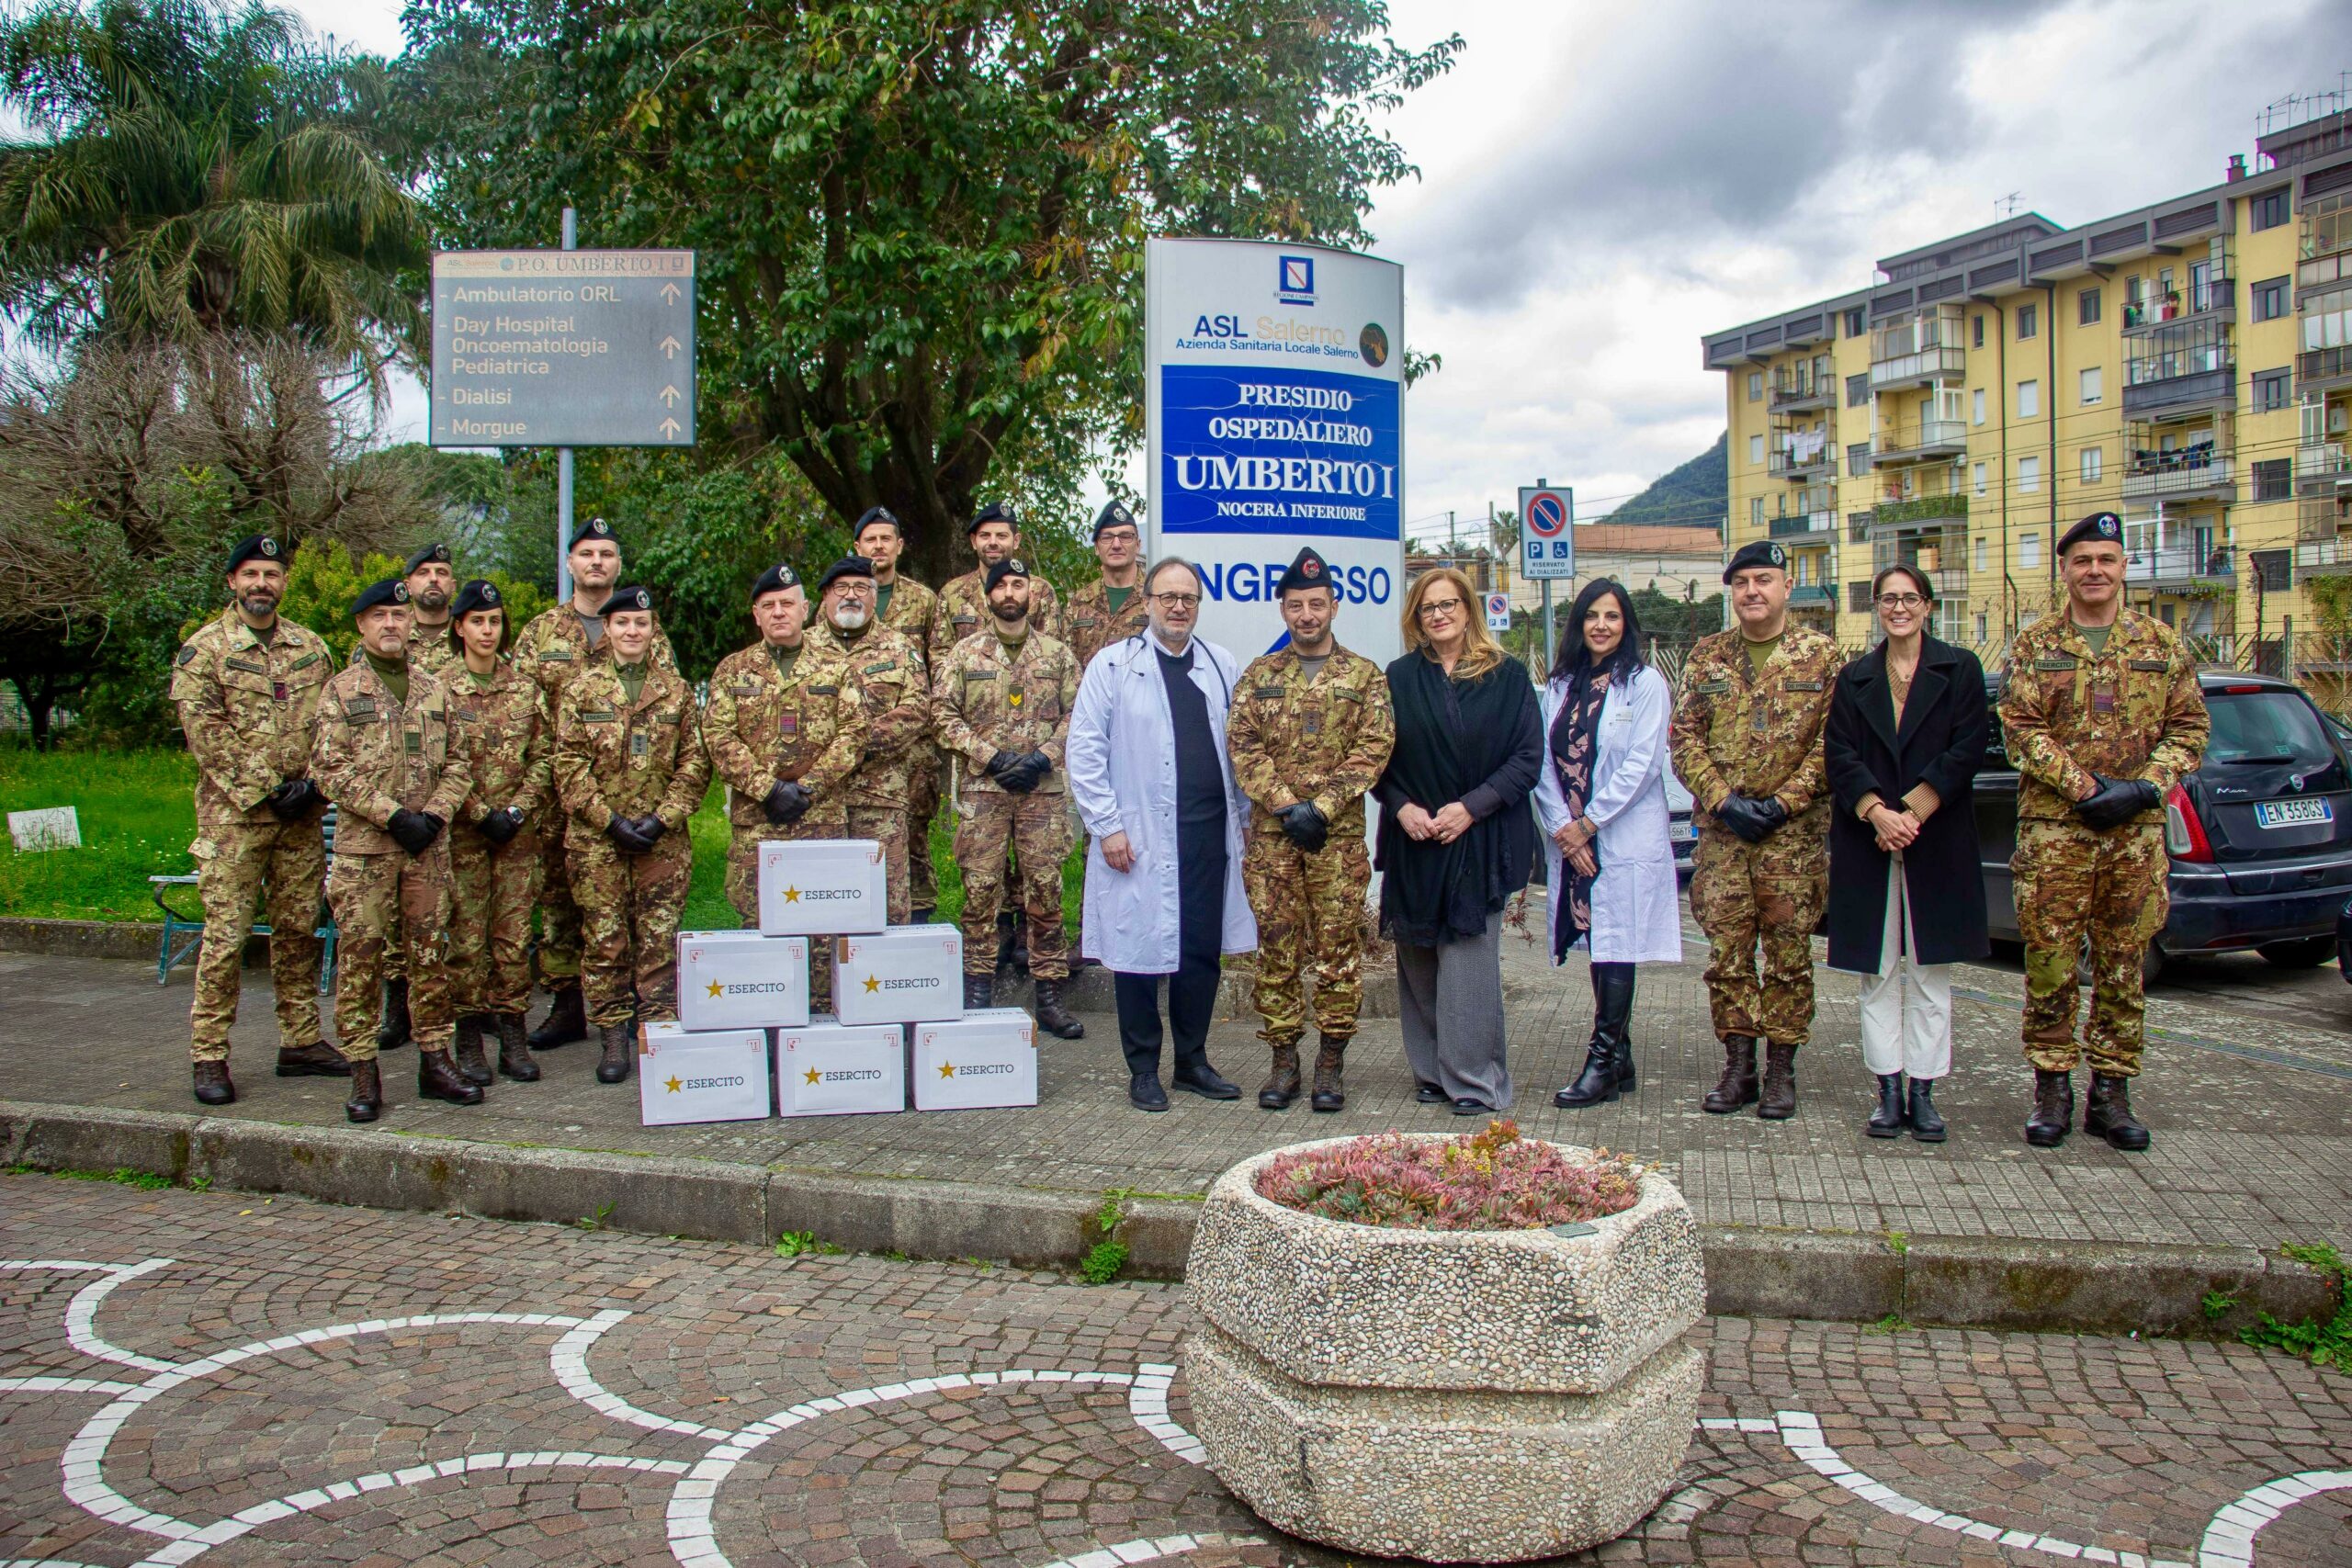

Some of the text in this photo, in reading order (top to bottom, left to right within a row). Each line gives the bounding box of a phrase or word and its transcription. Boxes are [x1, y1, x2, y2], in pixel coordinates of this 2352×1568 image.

[557, 256, 652, 272] UMBERTO
[657, 256, 664, 271] I
[453, 286, 621, 303] Ambulatorio ORL
[453, 316, 575, 337] Day Hospital
[1193, 315, 1346, 345] ASL Salerno
[452, 336, 608, 357] Oncoematologia
[1176, 338, 1359, 360] Azienda Sanitaria Locale Salerno
[452, 358, 549, 375] Pediatrica
[452, 388, 512, 405] Dialisi
[1238, 384, 1353, 412] PRESIDIO
[452, 418, 526, 439] Morgue
[1208, 417, 1373, 447] OSPEDALIERO
[1174, 455, 1394, 499] UMBERTO I
[1217, 502, 1366, 522] NOCERA INFERIORE
[1701, 683, 1726, 692] ESERCITO
[2266, 800, 2324, 822] EN 358GS
[804, 888, 862, 900] ESERCITO
[728, 982, 786, 995] ESERCITO
[884, 976, 940, 989] ESERCITO
[825, 1069, 882, 1082] ESERCITO
[959, 1064, 1014, 1076] ESERCITO
[686, 1076, 744, 1089] ESERCITO
